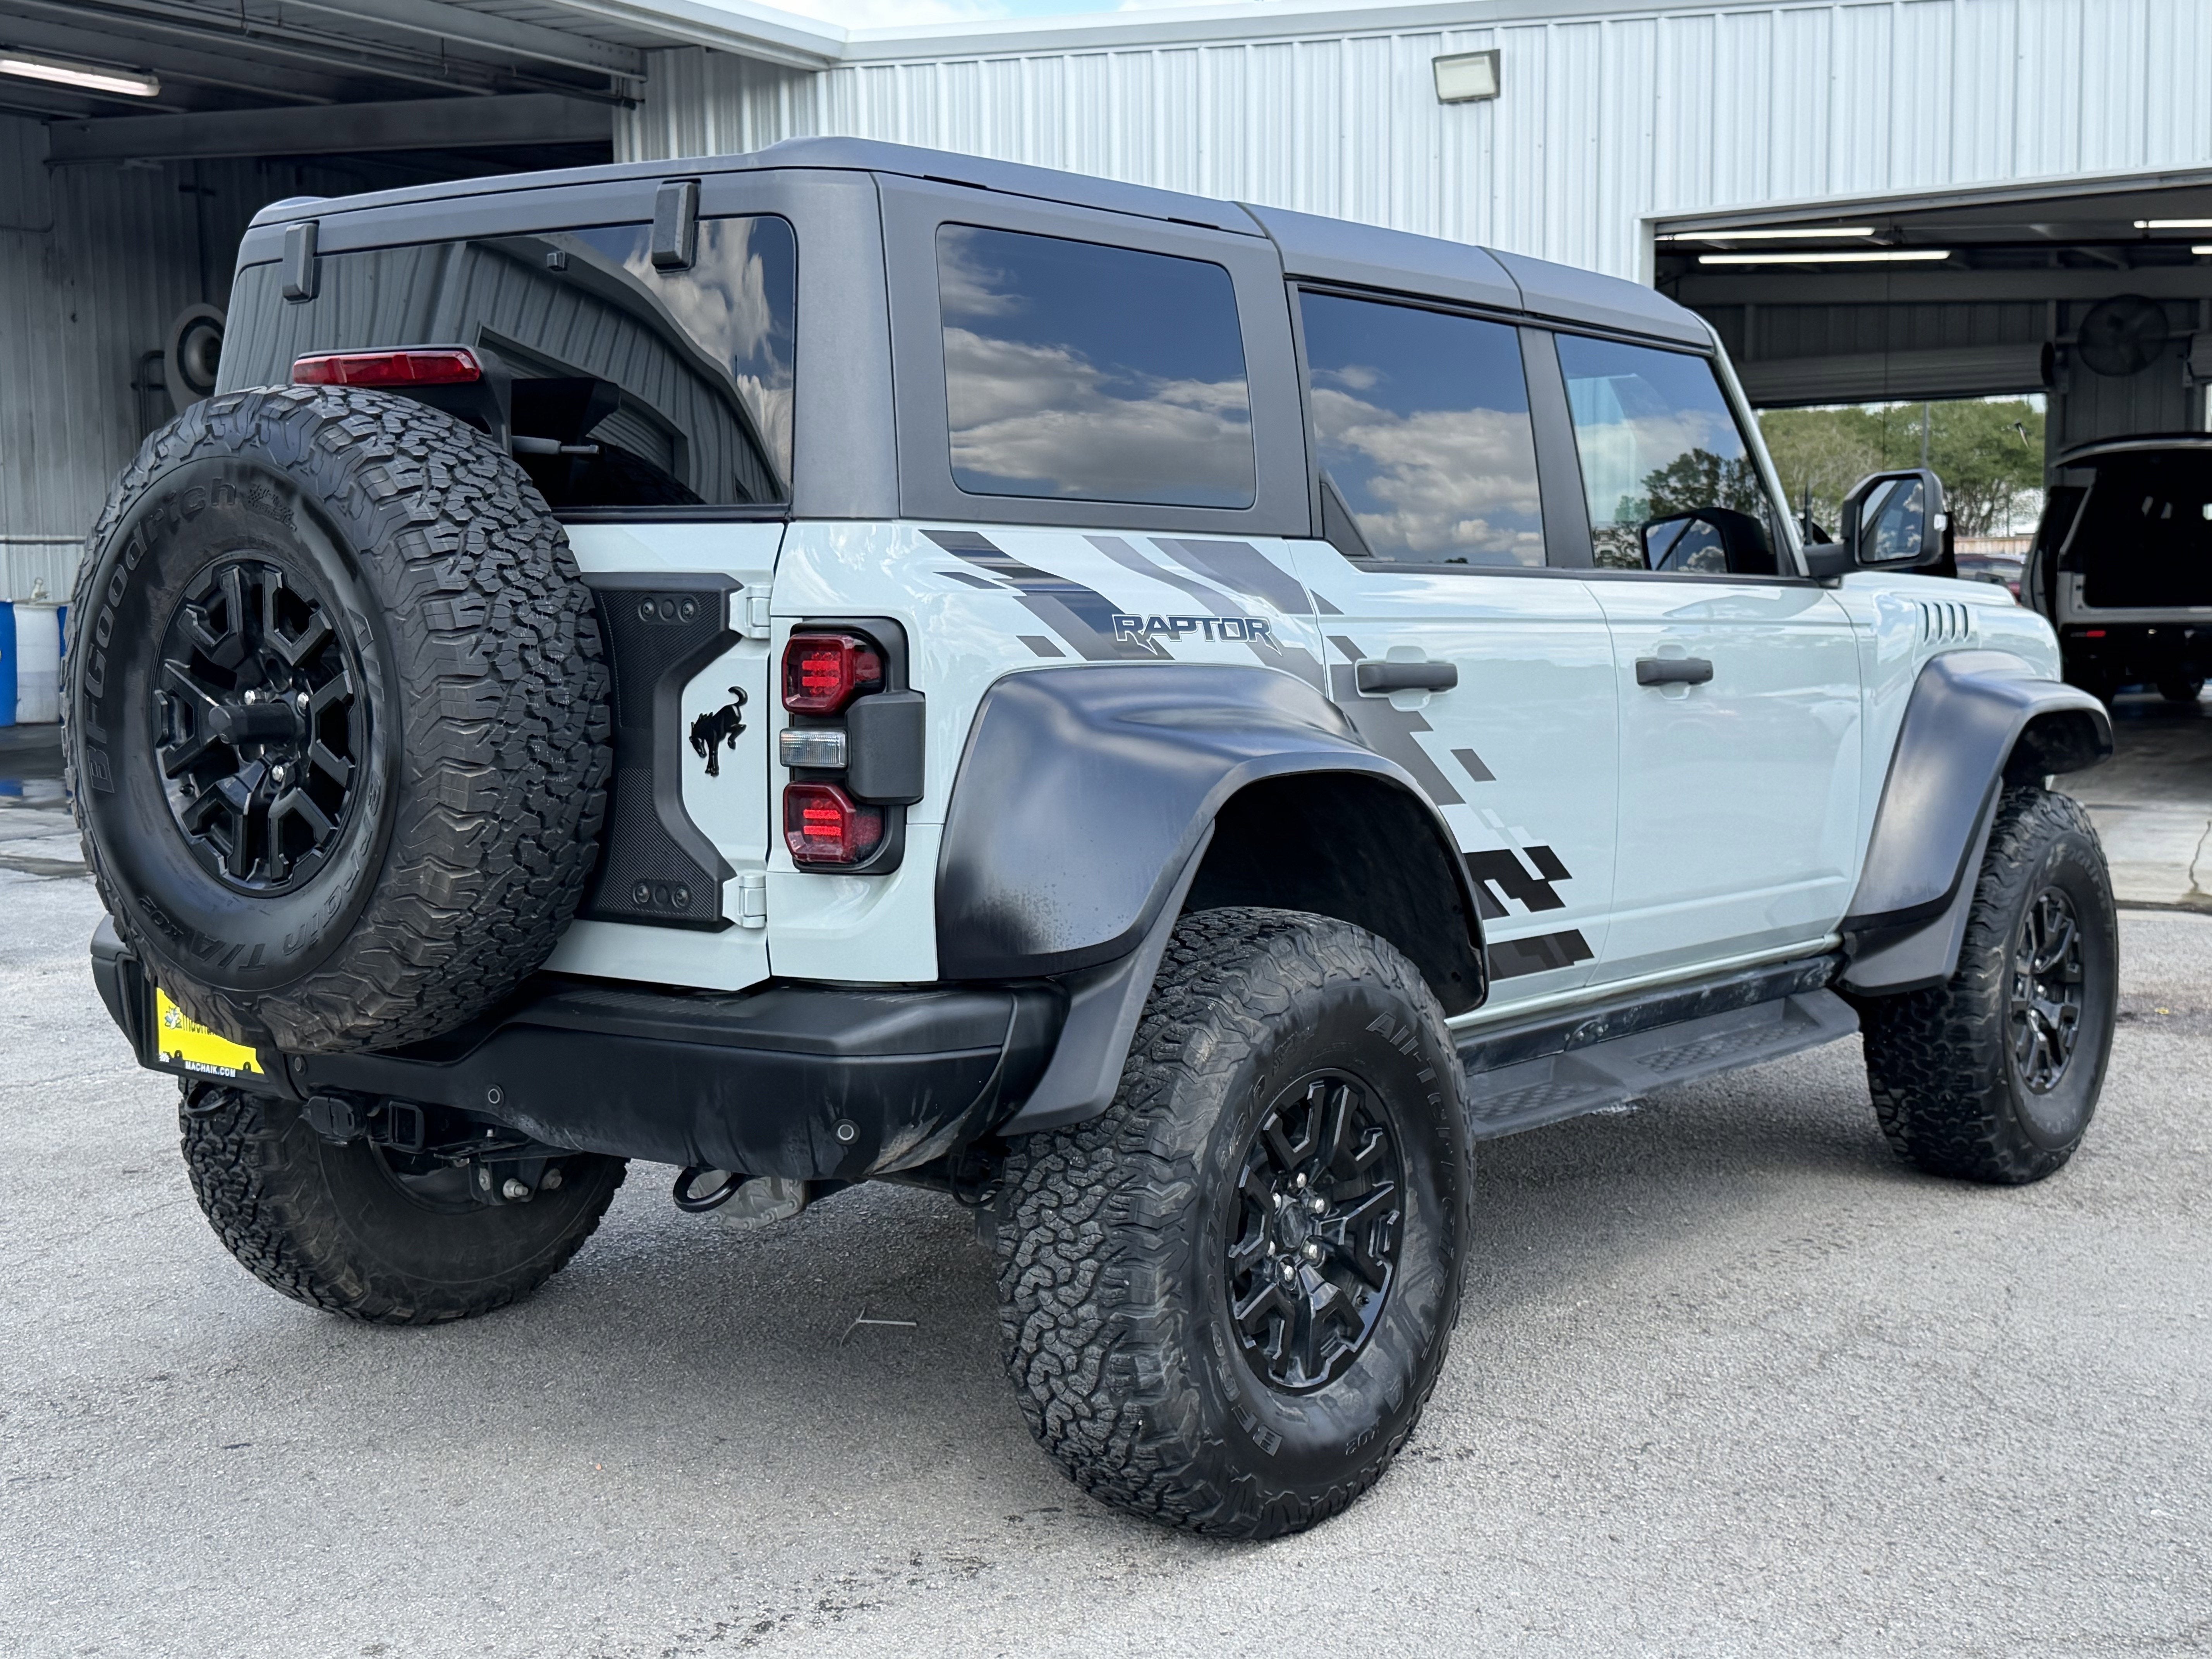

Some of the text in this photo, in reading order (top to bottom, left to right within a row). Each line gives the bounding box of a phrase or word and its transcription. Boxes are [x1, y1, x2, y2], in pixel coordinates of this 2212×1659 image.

[84, 478, 237, 793] BFGoodrich
[1112, 614, 1282, 656] RAPTOR
[185, 1060, 236, 1078] MACHAIK.COM
